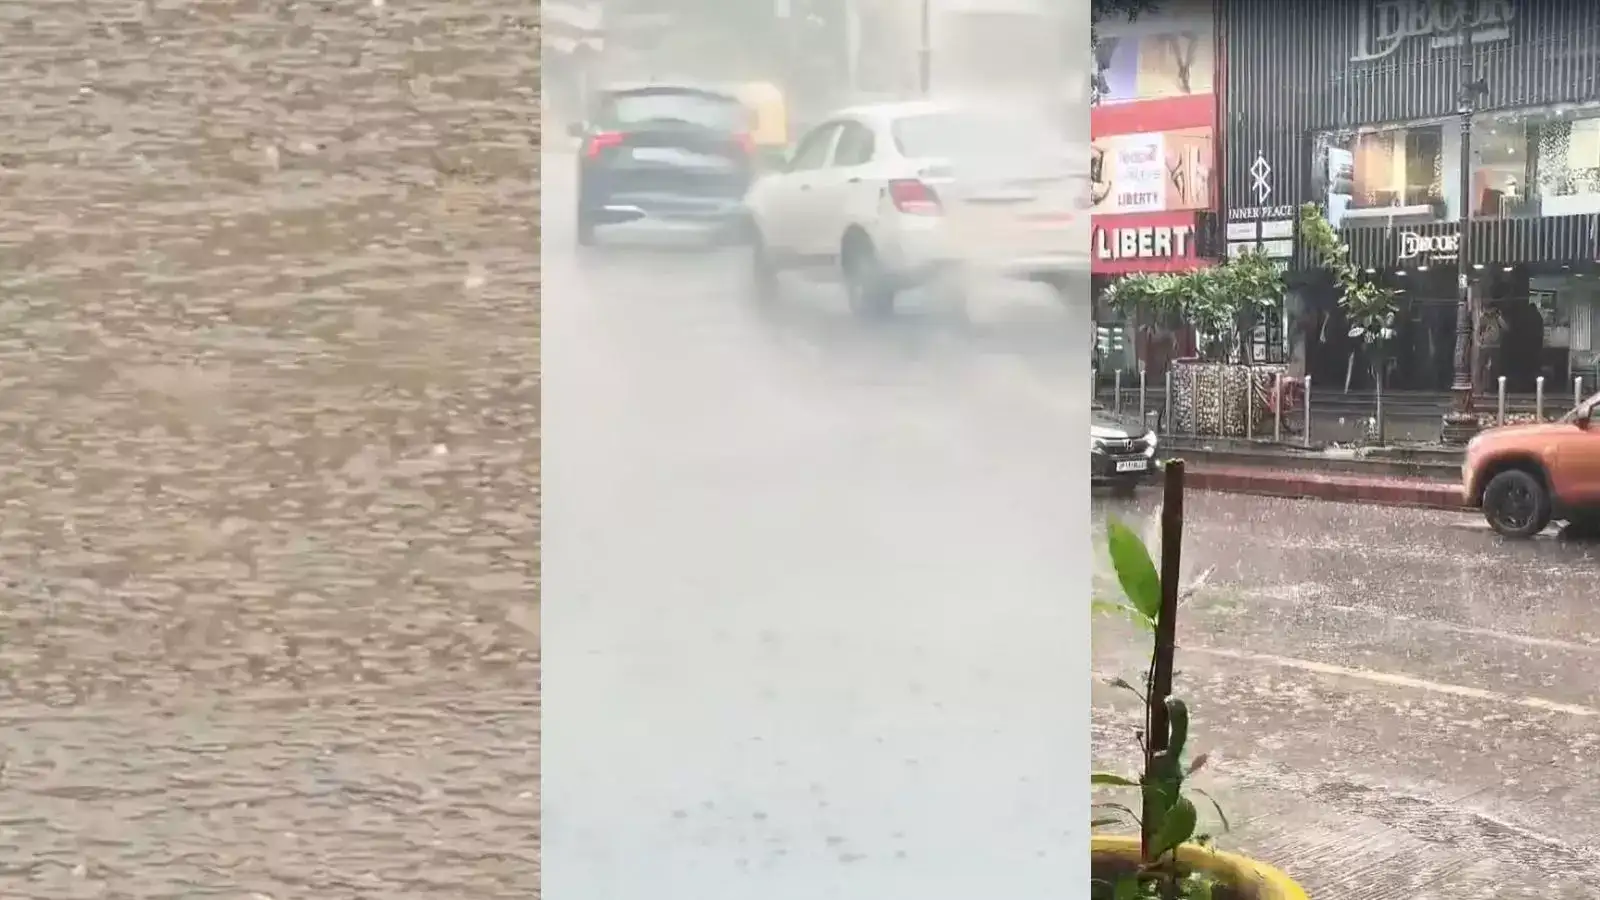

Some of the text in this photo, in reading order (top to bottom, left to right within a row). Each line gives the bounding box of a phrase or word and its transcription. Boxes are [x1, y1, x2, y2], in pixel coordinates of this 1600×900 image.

[1229, 205, 1293, 219] INNER PEACE
[1098, 224, 1195, 259] LIBERT
